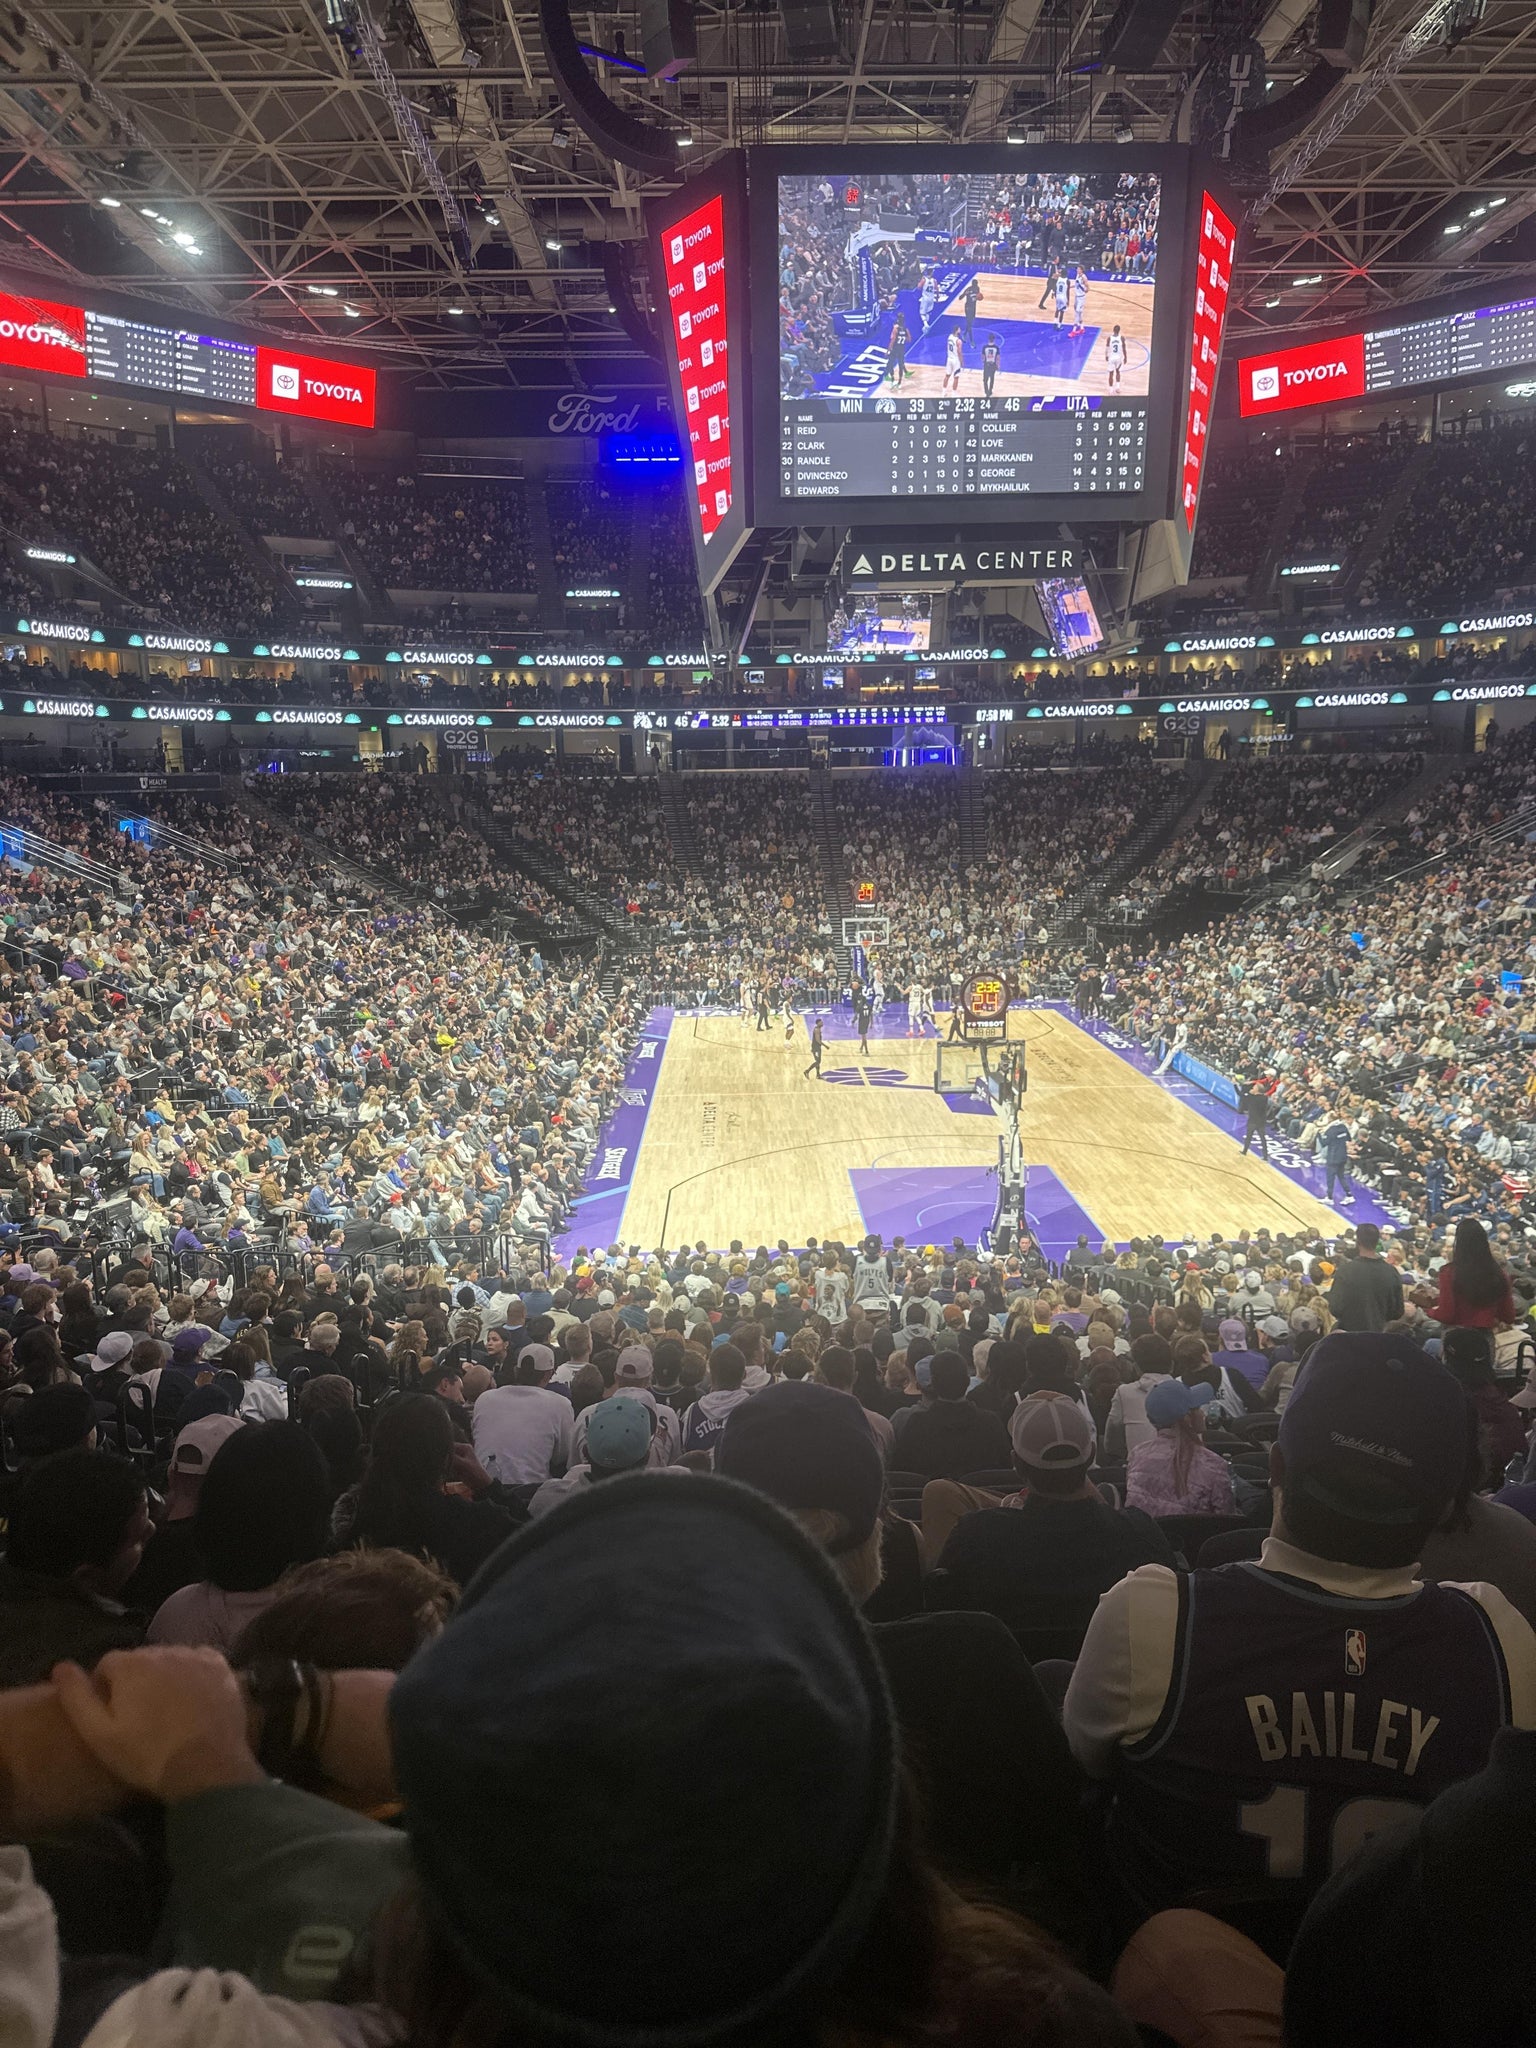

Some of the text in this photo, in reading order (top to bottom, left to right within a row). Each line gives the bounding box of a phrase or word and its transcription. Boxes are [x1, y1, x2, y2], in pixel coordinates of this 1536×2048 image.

[685, 224, 712, 249] TOYOTA
[692, 303, 720, 325] TOYOTA
[1284, 360, 1348, 387] TOYOTA
[304, 378, 363, 404] TOYOTA
[700, 380, 727, 401] TOYOTA
[840, 399, 863, 413] MIN
[909, 399, 925, 412] 39
[955, 398, 975, 412] 2:32
[980, 399, 991, 410] 24
[1004, 398, 1020, 412] 46
[1067, 396, 1089, 410] UTA
[547, 393, 641, 433] Ford
[784, 422, 1145, 435] 11 REID 7 3 0 12 1 8 COLLIER 5 3 5 09 2
[782, 436, 1144, 451] 22 CLARK 0 1 0 07 1 42 LOVE 3 1 1 09 2
[707, 456, 732, 474] TOYOTA
[782, 452, 1142, 466] 30 RANDLE 2 2 3 15 0 23 MARKKANEN 10 4 2 14 1
[784, 466, 1142, 481] 0 DIVINCENZO 3 0 1 13 0 3 GEORGE 14 4 3 15 0
[784, 480, 1141, 496] 5 EDWARDS 8 3 1 15 0 10 MYKHAILIUK 3 3 1 11 0
[881, 549, 1074, 572] DELTA CENTER
[1291, 564, 1331, 575] CASAMIGOS
[305, 578, 344, 589] CASAMIGOS
[575, 590, 612, 598] CASAMIGOS
[1459, 613, 1534, 633] CASAMIGOS
[30, 621, 91, 642] CASAMIGOS
[1321, 627, 1396, 644] CASAMIGOS
[145, 635, 212, 653] CASAMIGOS
[1183, 636, 1257, 652] CASAMIGOS
[271, 645, 342, 661] CASAMIGOS
[403, 652, 475, 665] CASAMIGOS
[536, 654, 606, 666] CASAMIGOS
[1315, 693, 1389, 708] CASAMIGOS
[1452, 684, 1526, 702] CASAMIGOS
[37, 700, 95, 717] CASAMIGOS
[1045, 704, 1115, 718] CASAMIGOS
[1177, 698, 1251, 713] CASAMIGOS
[149, 706, 214, 722] CASAMIGOS
[273, 710, 343, 724] CASAMIGOS
[404, 714, 475, 726] CASAMIGOS
[536, 714, 605, 726] CASAMIGOS
[656, 716, 668, 728] 41
[674, 716, 688, 728] 46
[712, 715, 730, 727] 2:32
[1000, 709, 1013, 720] PM
[1164, 716, 1200, 731] G2G
[444, 730, 479, 744] G2G
[858, 890, 872, 900] 24
[976, 982, 1000, 993] 2:32
[972, 994, 998, 1012] 24
[595, 1147, 628, 1180] SEATGEEK
[868, 1278, 874, 1288] 5
[1245, 1690, 1441, 1776] BAILEY
